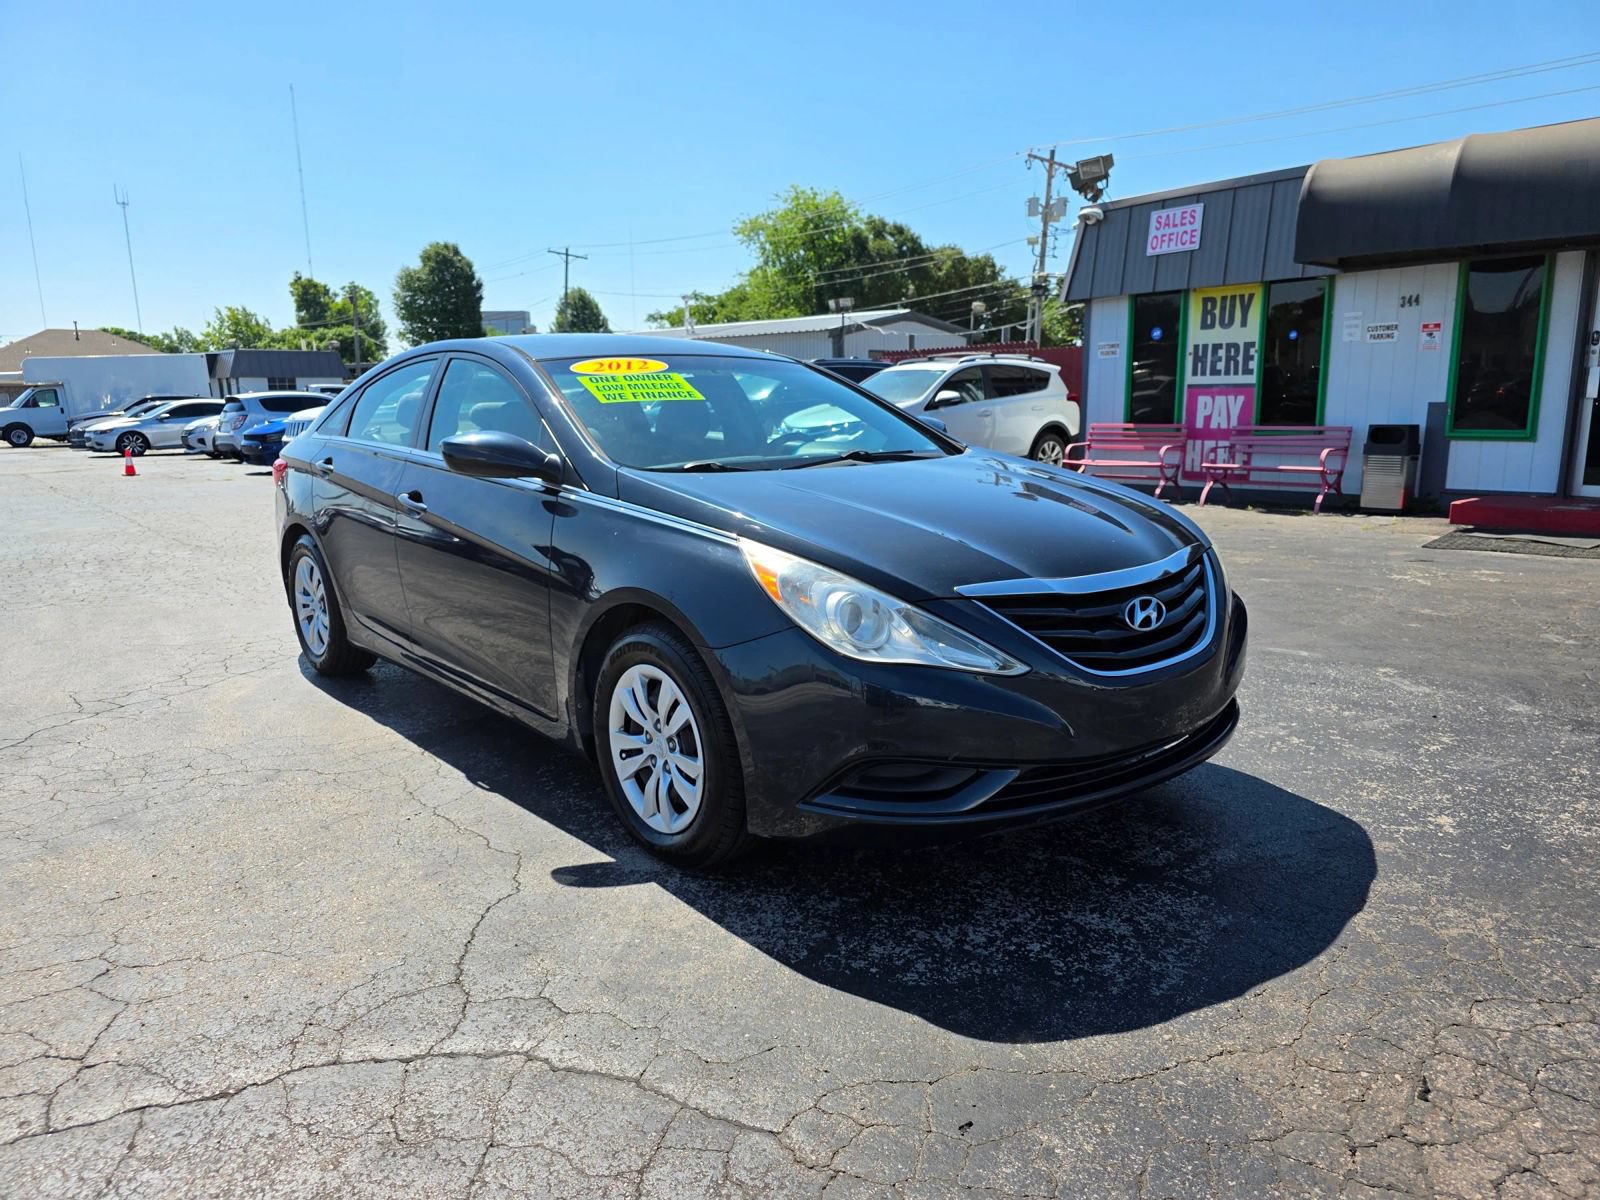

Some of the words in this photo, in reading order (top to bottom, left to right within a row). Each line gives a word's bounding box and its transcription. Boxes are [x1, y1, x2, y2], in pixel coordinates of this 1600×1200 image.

[1154, 208, 1197, 231] SALES
[1150, 229, 1198, 251] OFFICE
[1400, 294, 1420, 308] 344
[1199, 293, 1256, 331] BUY
[1367, 324, 1399, 332] CUSTOMER
[1369, 332, 1395, 340] PARKING
[1191, 341, 1257, 377] HERE
[593, 360, 649, 372] 2012
[589, 375, 619, 384] ONE
[623, 374, 674, 382] OWNER
[595, 383, 624, 392] LOW
[627, 382, 685, 391] MILEAGE
[602, 392, 628, 401] WE
[631, 391, 698, 400] FINANCE
[1195, 395, 1245, 429] PAY
